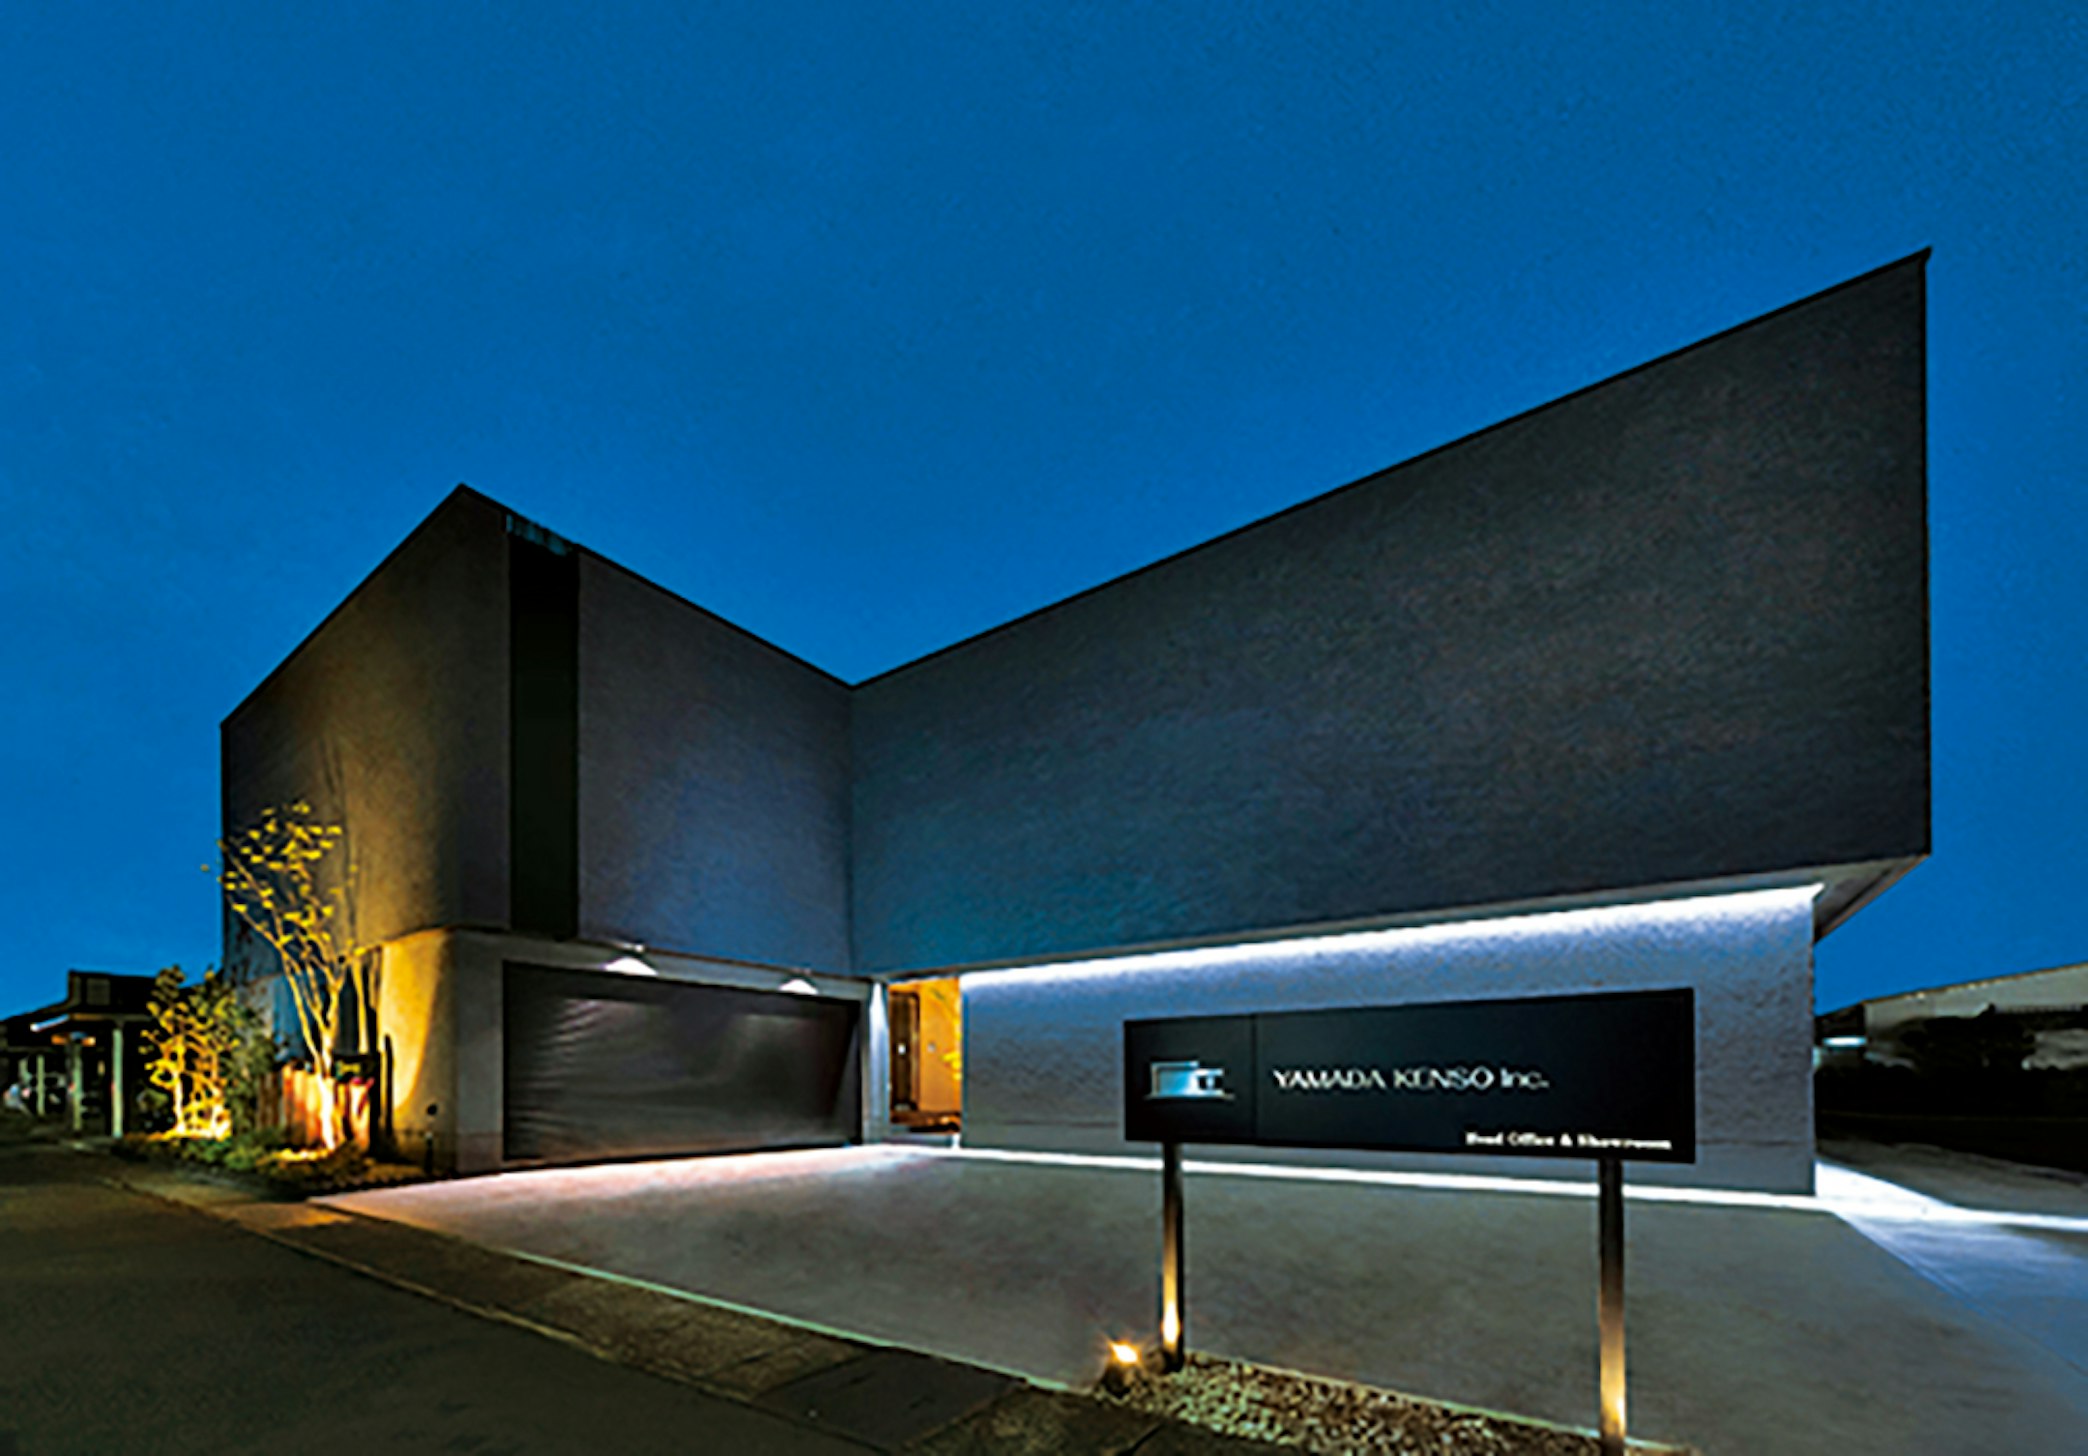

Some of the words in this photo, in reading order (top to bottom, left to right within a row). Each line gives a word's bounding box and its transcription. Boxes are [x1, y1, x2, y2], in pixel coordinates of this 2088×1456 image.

[1273, 1069, 1387, 1089] YAMADA
[1393, 1067, 1495, 1090] KENSO
[1500, 1068, 1549, 1089] Inc.
